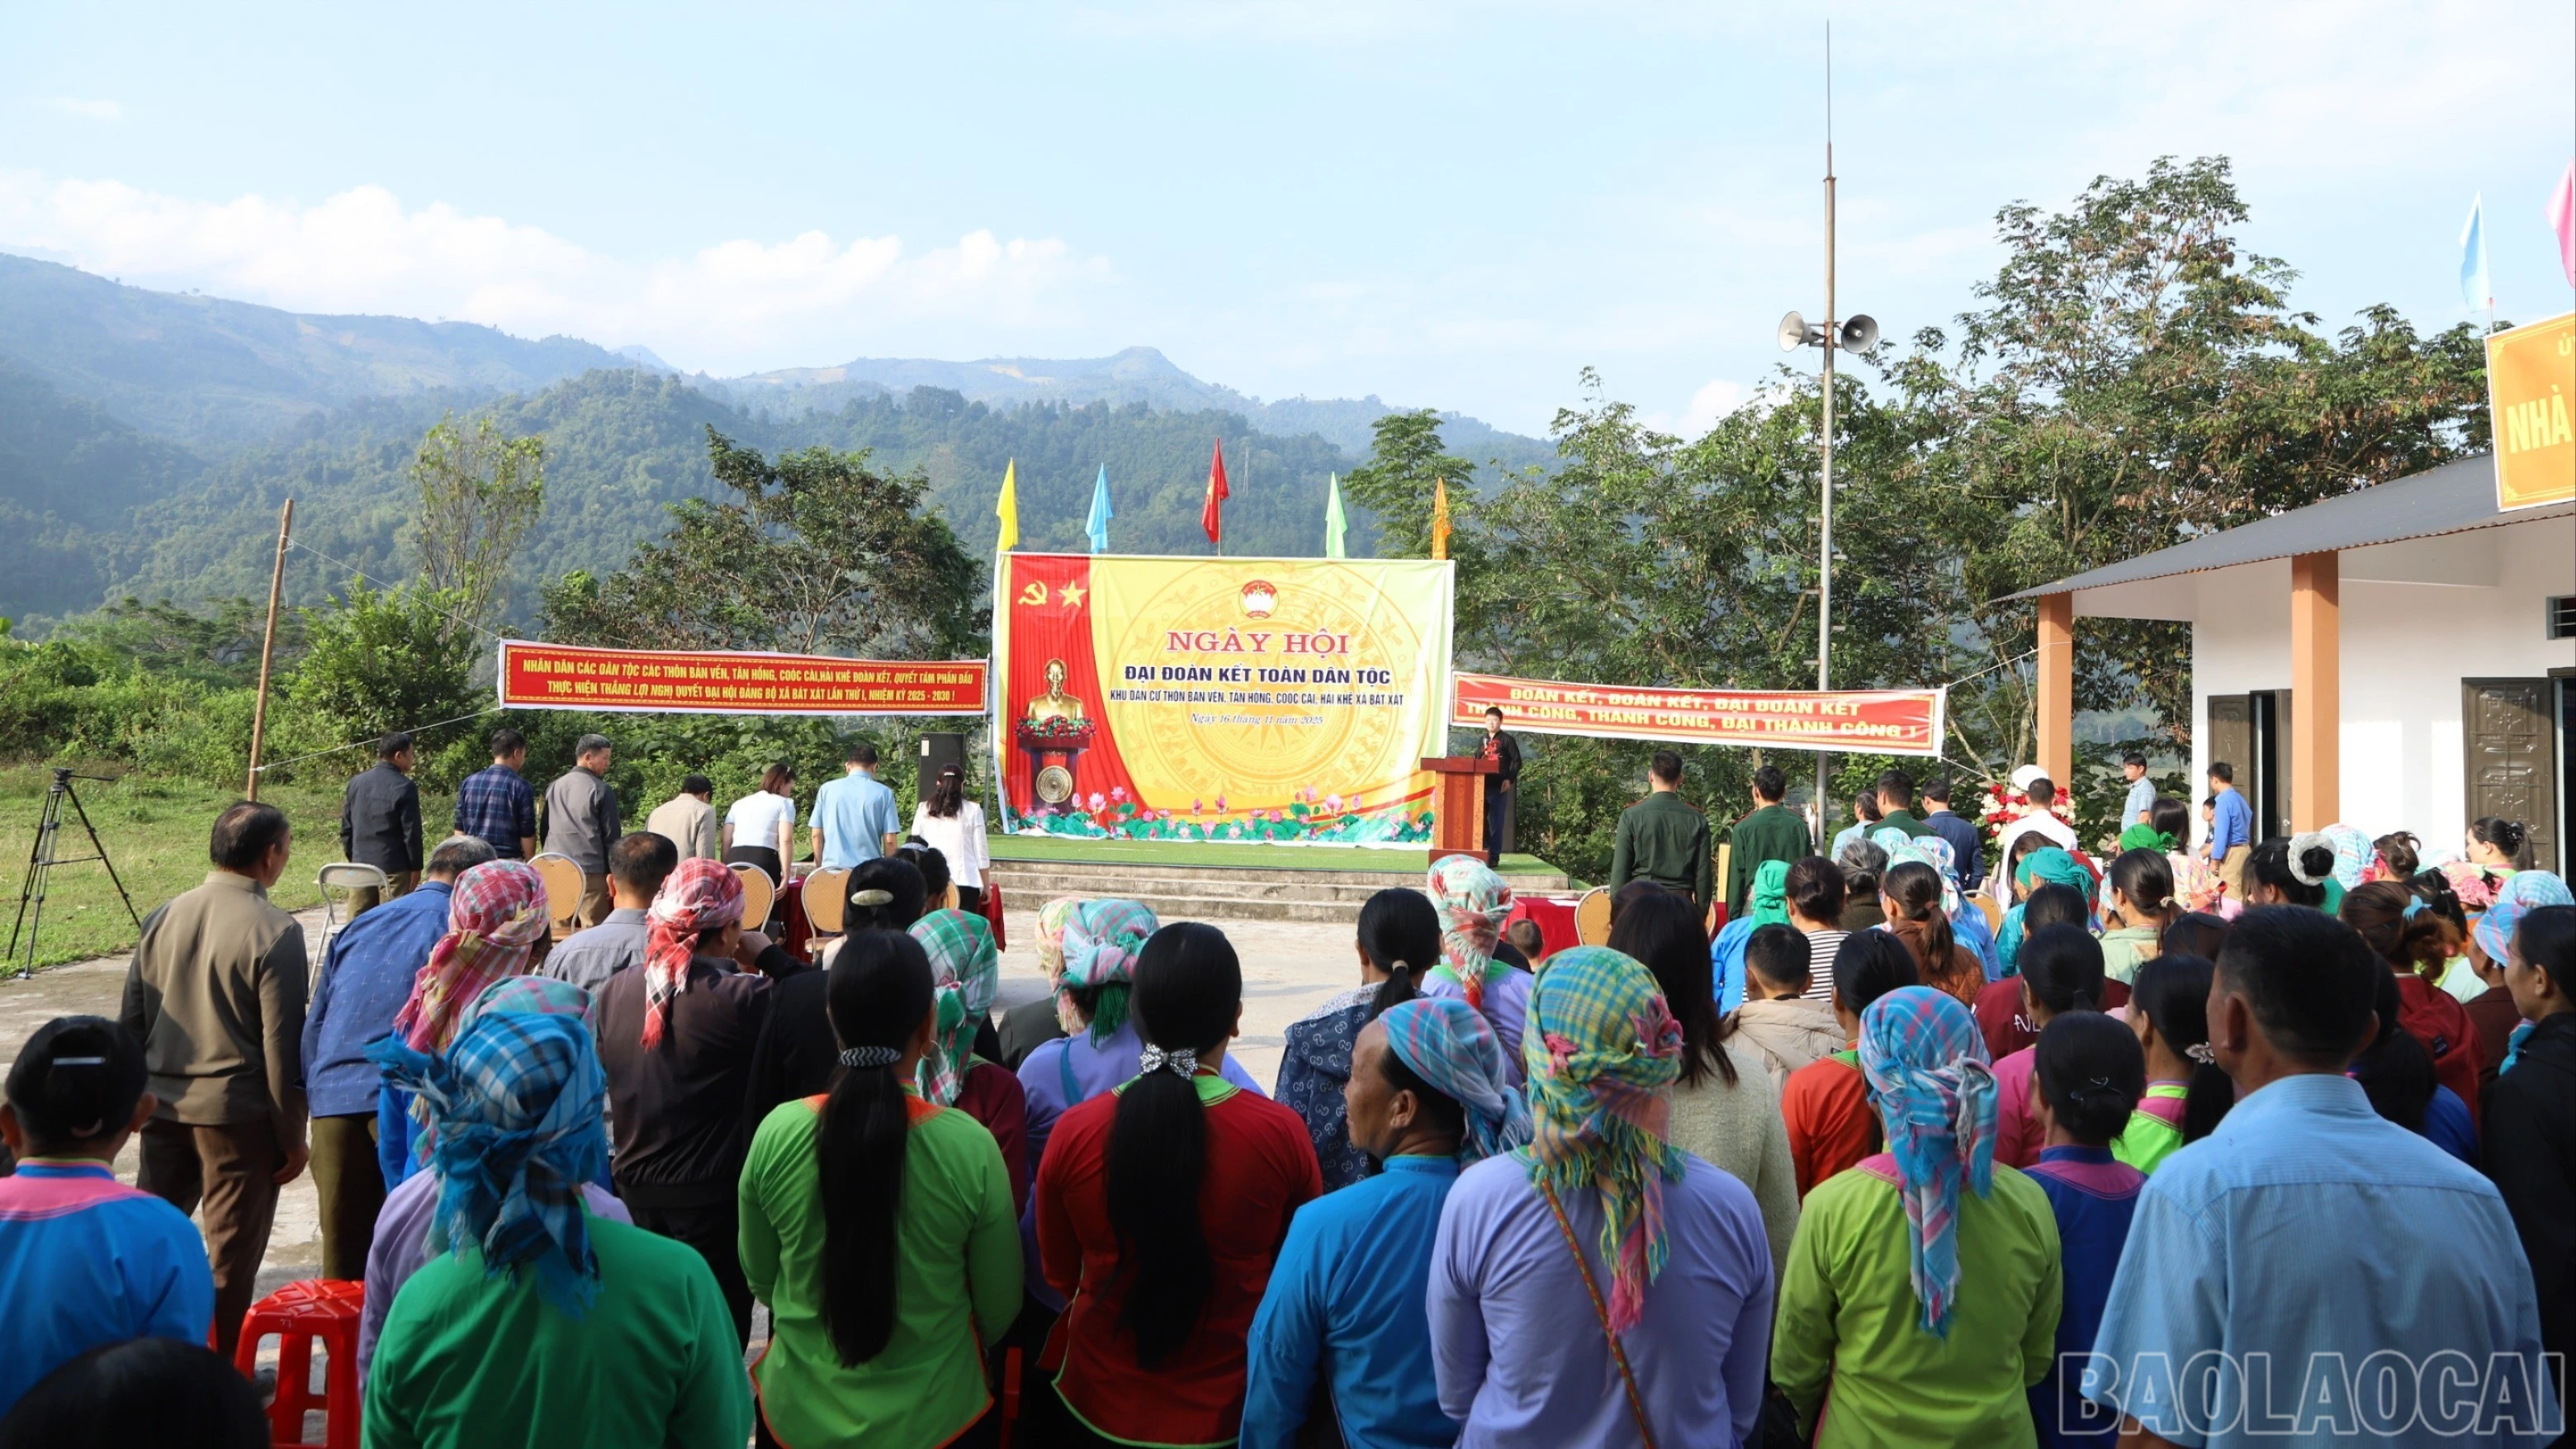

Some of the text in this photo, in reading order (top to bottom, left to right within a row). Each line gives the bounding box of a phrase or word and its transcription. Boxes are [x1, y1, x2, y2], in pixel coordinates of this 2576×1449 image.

[2506, 383, 2574, 454] NHÀ
[1167, 627, 1349, 658] NGÀY HỘI
[523, 657, 551, 673] NHÂN
[554, 659, 574, 674] DÂN
[577, 661, 596, 675] CÁC
[599, 661, 619, 676] DÂN
[622, 662, 639, 679] TỘC
[642, 663, 661, 677] CÁC
[663, 664, 686, 678] THÔN
[689, 662, 708, 679] BẢN
[732, 665, 749, 680] TÂN
[836, 669, 851, 683] KHÊ
[853, 670, 874, 683] ĐOÀN
[876, 669, 893, 684] KẾT,
[894, 670, 917, 684] QUYẾT
[919, 671, 935, 684] TÂM
[936, 670, 957, 684] PHẤN
[959, 670, 973, 684] ĐẤU
[1125, 663, 1390, 687] ĐẠI ĐOÀN KẾT TOÀN DÂN TỘC
[547, 680, 572, 696] THỰC
[575, 680, 598, 697] HIỆN
[600, 679, 631, 695] THẮNG
[633, 683, 648, 698] LỢI
[651, 684, 673, 699] NGHỊ
[675, 682, 703, 698] QUYẾT
[705, 686, 720, 700] ĐẠI
[722, 684, 738, 701] HỘI
[739, 682, 763, 699] ĐẢNG
[765, 686, 776, 702] BỘ
[779, 686, 790, 700] XÃ
[792, 687, 807, 700] BÁT
[810, 687, 825, 700] XÁT
[827, 685, 842, 700] LẦN
[845, 687, 860, 701] THỨ
[869, 687, 894, 703] NHIỆM
[896, 687, 906, 701] KỲ
[907, 690, 926, 701] 2025
[932, 690, 950, 701] 2030
[1110, 689, 1127, 700] KHU
[1129, 689, 1147, 701] DÂN
[1149, 689, 1162, 701] CƯ
[1163, 689, 1185, 702] THÔN
[1229, 690, 1245, 703] TÂN
[1337, 692, 1353, 704] KHÊ
[1510, 688, 1861, 716] ĐOÀN KẾT, ĐOÀN KẾT, ĐẠI ĐOÀN KẾT
[1191, 713, 1217, 724] Ngày
[1219, 714, 1230, 722] 16
[1233, 713, 1262, 724] tháng
[1276, 715, 1297, 724] năm
[1528, 706, 1582, 722] CÔNG,
[1587, 708, 1649, 724] THÀNH
[1655, 713, 1716, 729] CÔNG,
[1721, 717, 1756, 732] ĐẠI
[1763, 718, 1833, 733] THÀNH
[1840, 721, 1901, 737] CÔNG
